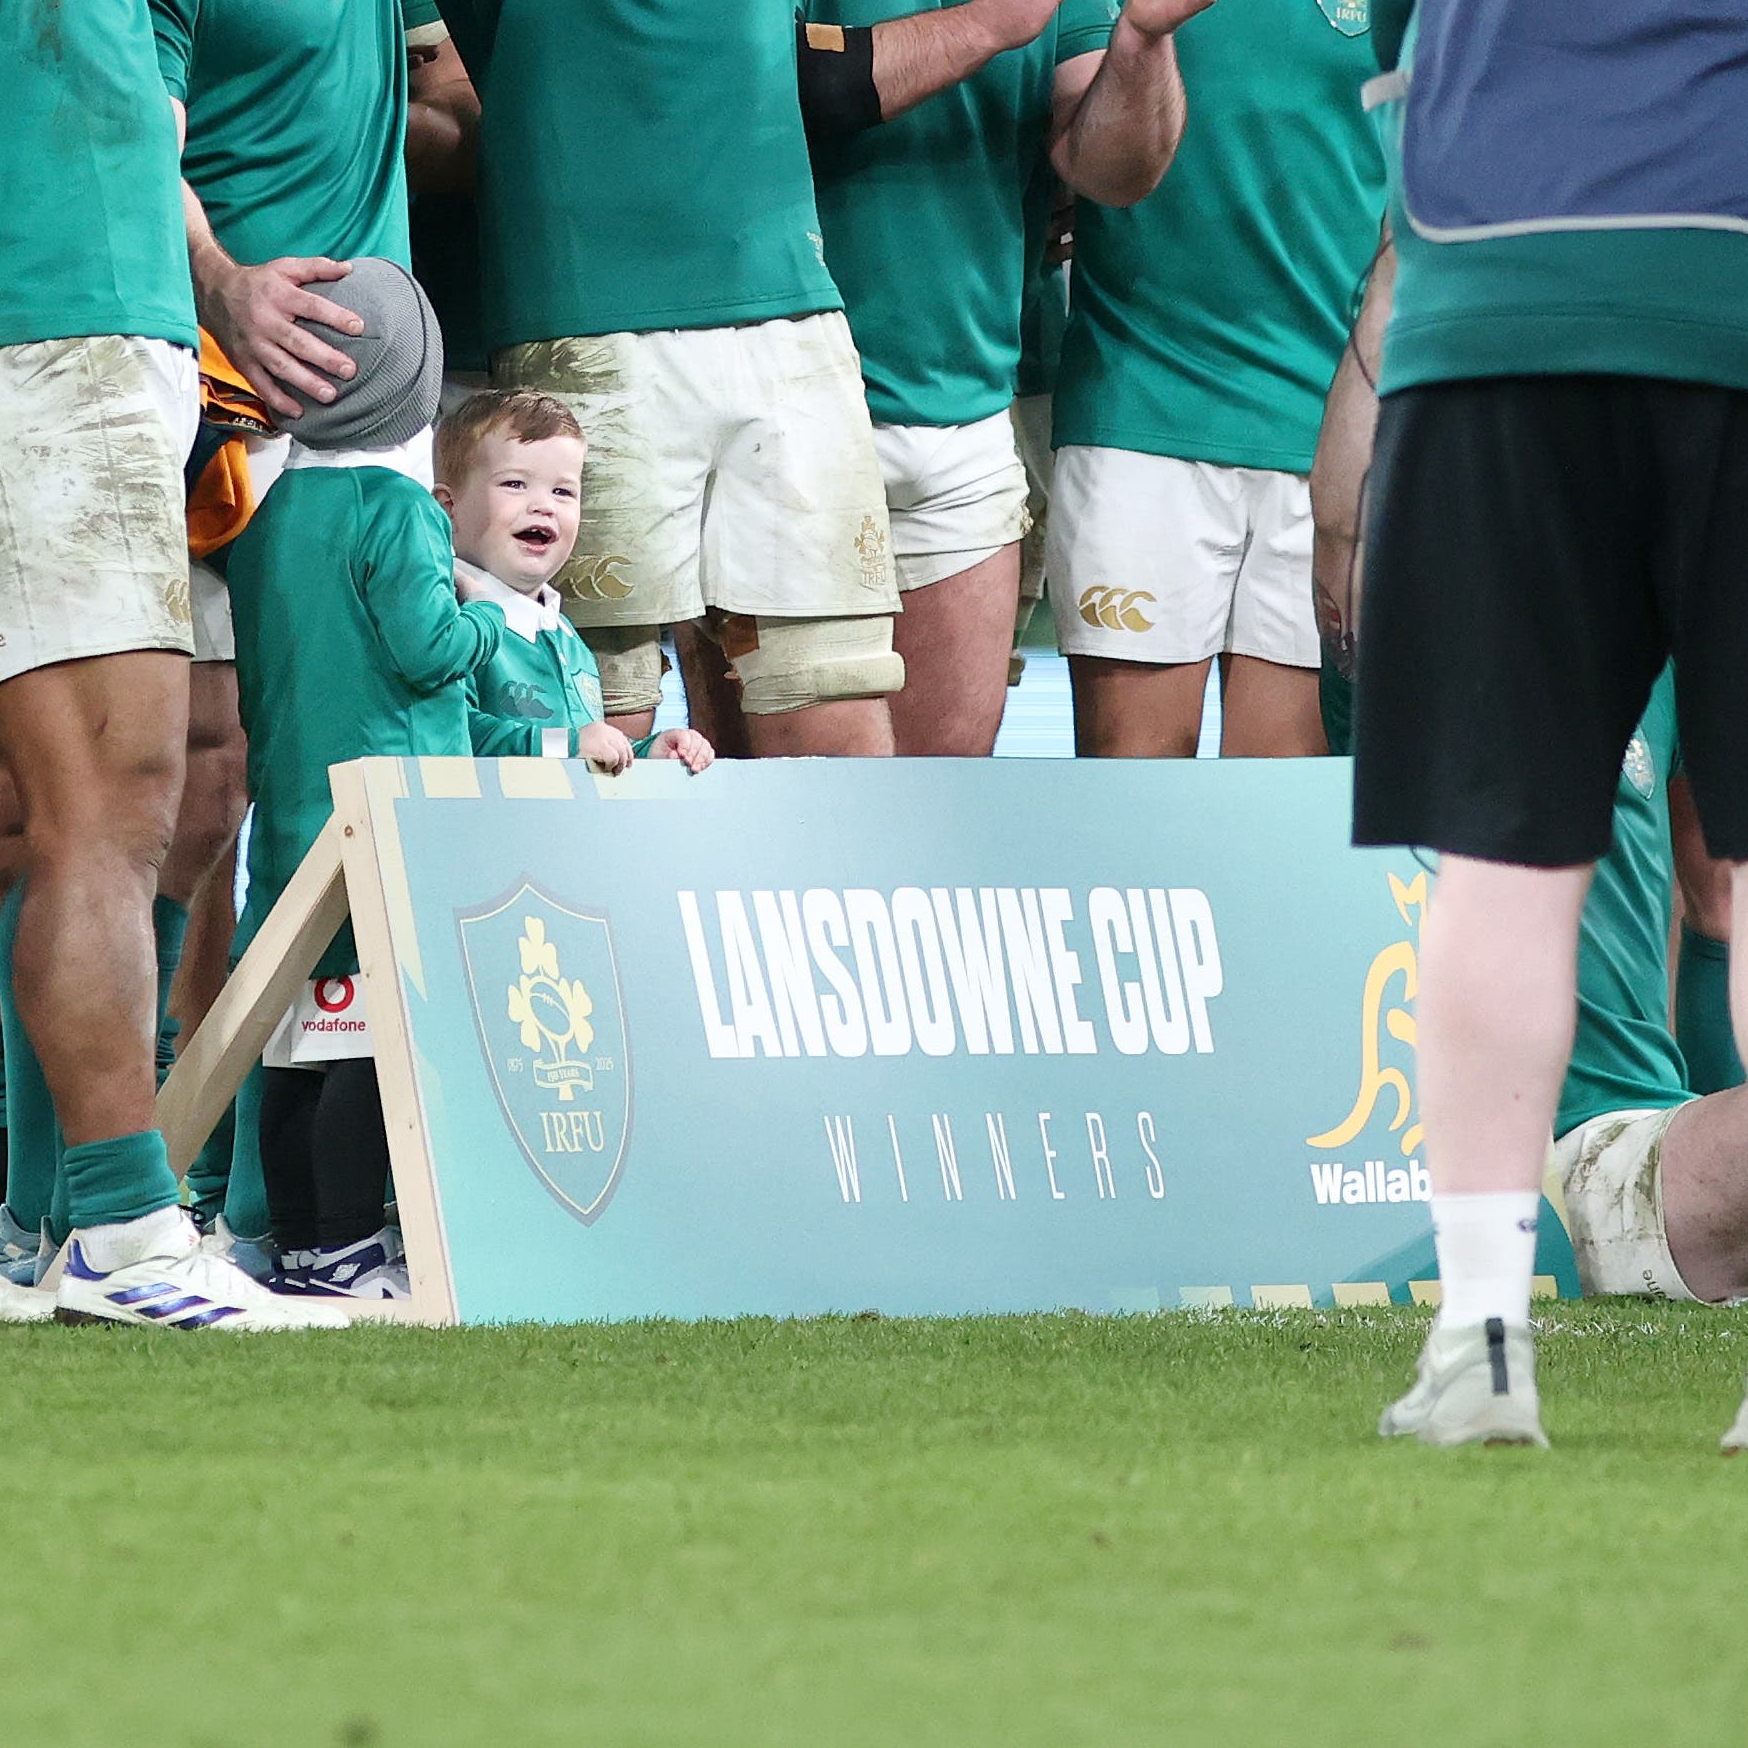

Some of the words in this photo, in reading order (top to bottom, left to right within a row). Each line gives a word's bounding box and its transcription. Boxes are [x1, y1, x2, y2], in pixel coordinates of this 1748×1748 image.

[676, 886, 1098, 1059] LANSDOWNE
[1088, 886, 1224, 1055] CUP
[301, 1018, 366, 1032] vodafone
[539, 1111, 605, 1153] IRFU
[824, 1111, 1165, 1203] WINNERS
[1309, 1159, 1433, 1205] Wallab
